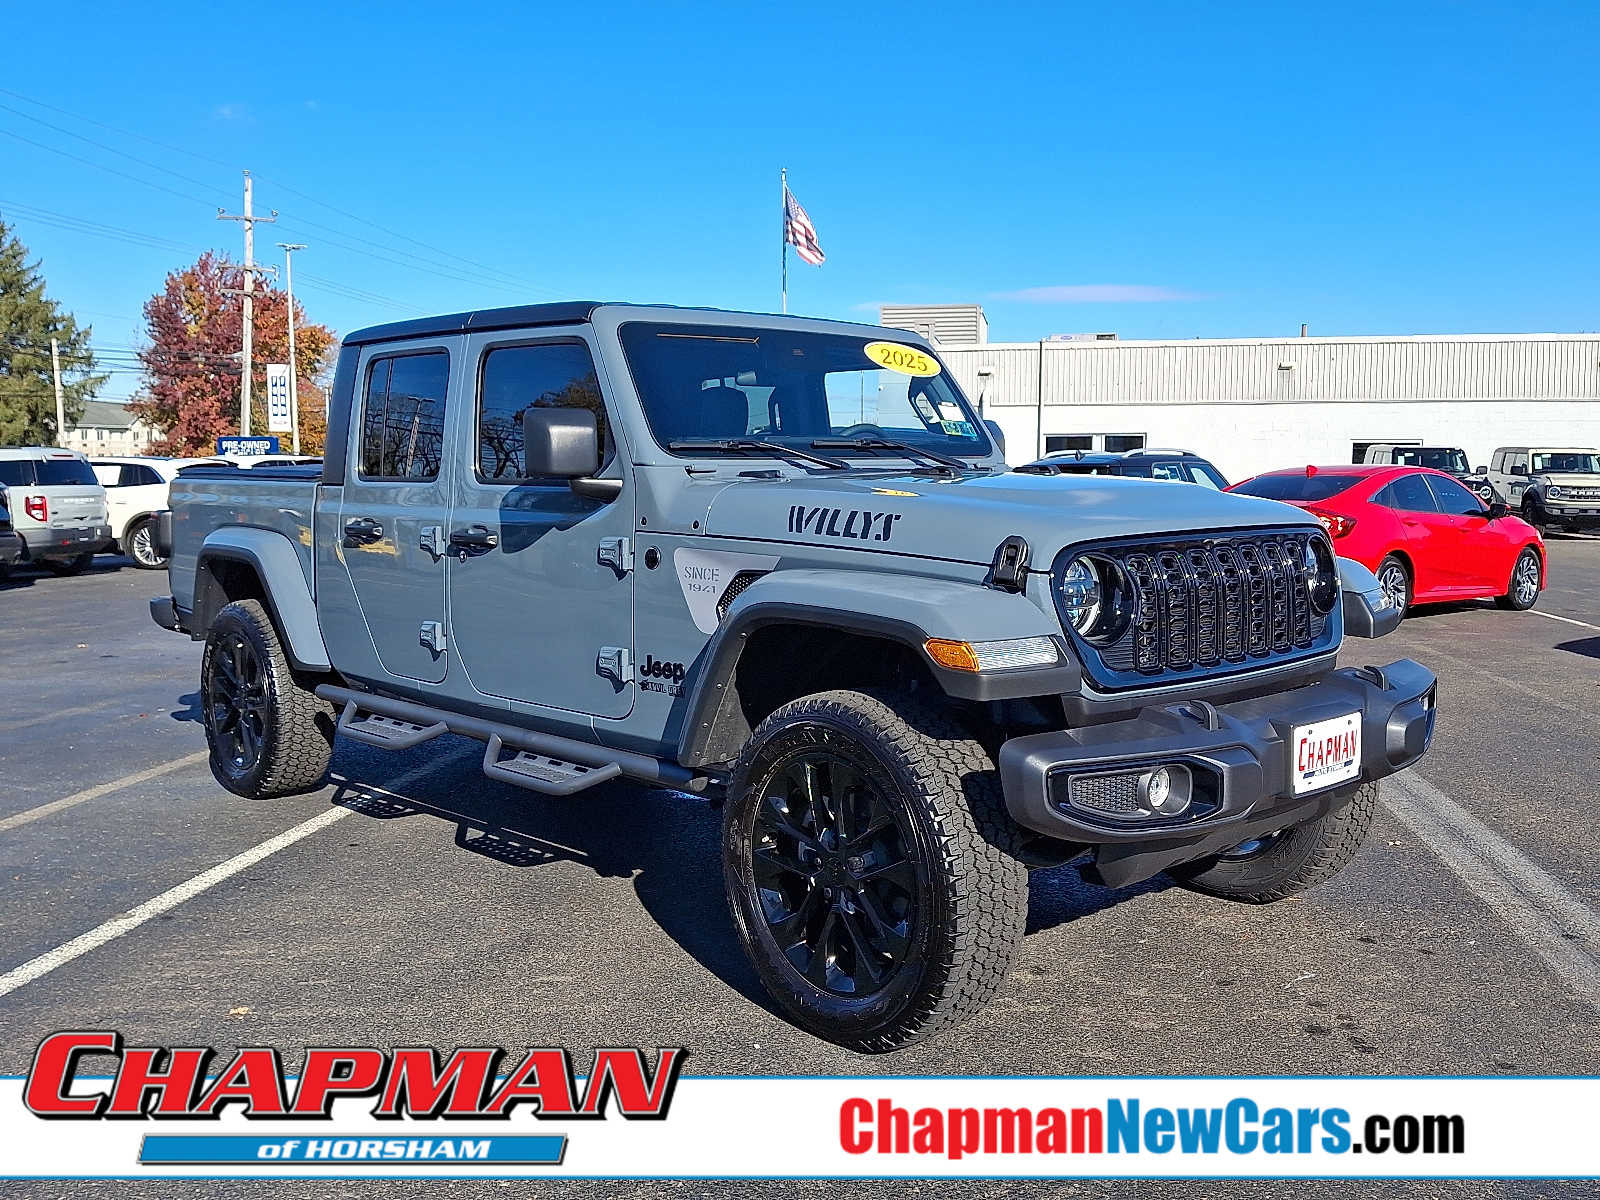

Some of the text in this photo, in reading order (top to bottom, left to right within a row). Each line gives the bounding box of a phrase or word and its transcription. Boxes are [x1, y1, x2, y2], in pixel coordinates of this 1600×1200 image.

[880, 348, 928, 372] 2025
[221, 440, 271, 451] PRE-OWNED
[788, 505, 902, 542] WILLYS
[684, 566, 720, 582] SINCE
[688, 583, 716, 594] 1941
[640, 654, 686, 684] Jeep
[1298, 729, 1358, 772] CHAPMAN
